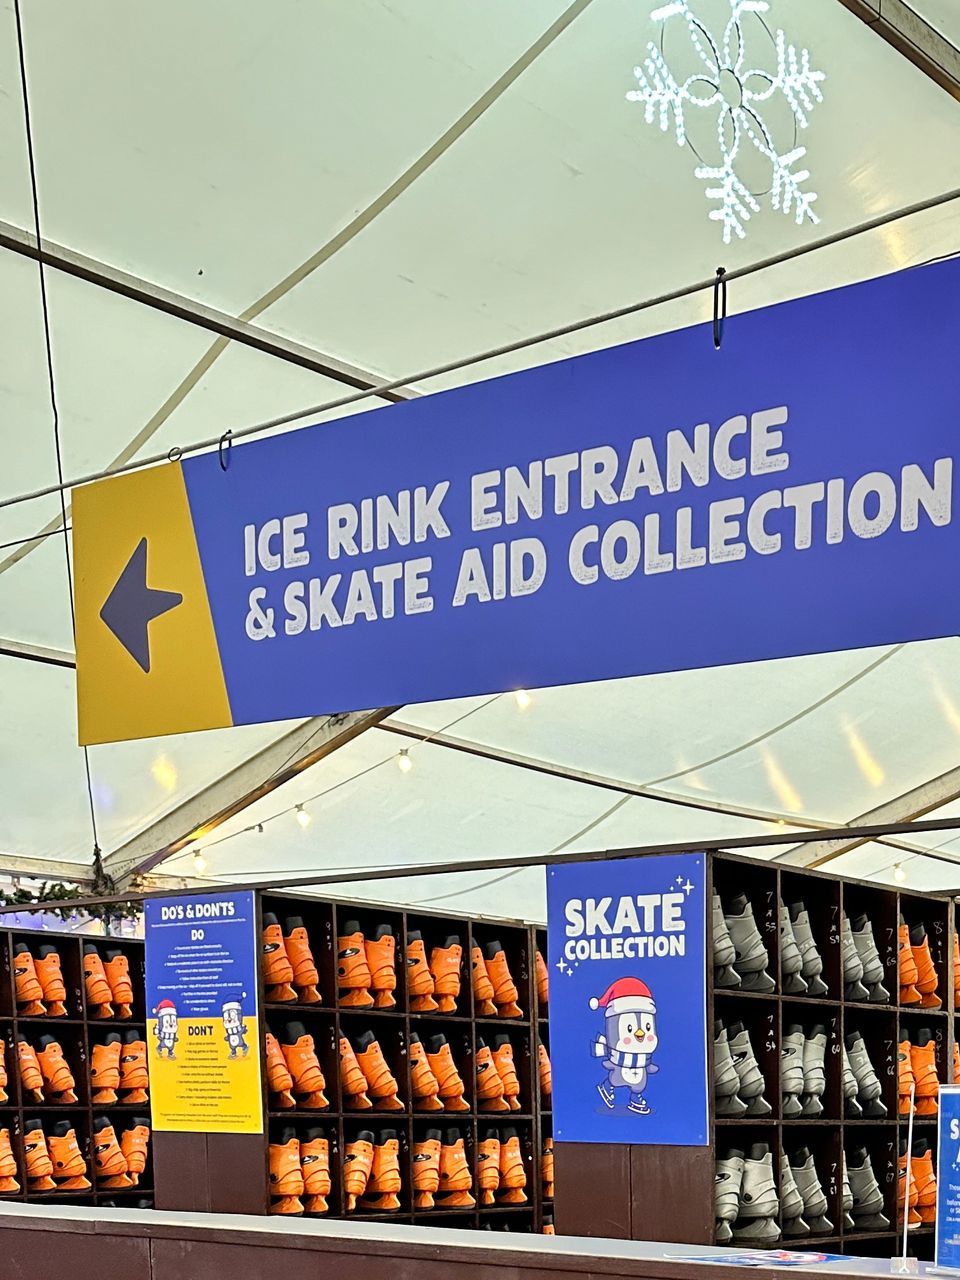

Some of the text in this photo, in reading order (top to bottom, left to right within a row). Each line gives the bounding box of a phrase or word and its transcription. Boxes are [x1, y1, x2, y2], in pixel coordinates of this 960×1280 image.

[244, 405, 790, 576] ICE RINK ENTRANCE
[245, 457, 954, 641] & SKATE AID COLLECTION
[161, 901, 235, 920] DO'S & DON'TS
[564, 893, 686, 937] SKATE
[191, 929, 204, 940] DO
[564, 934, 685, 960] COLLECTION
[188, 1025, 214, 1036] DON'T
